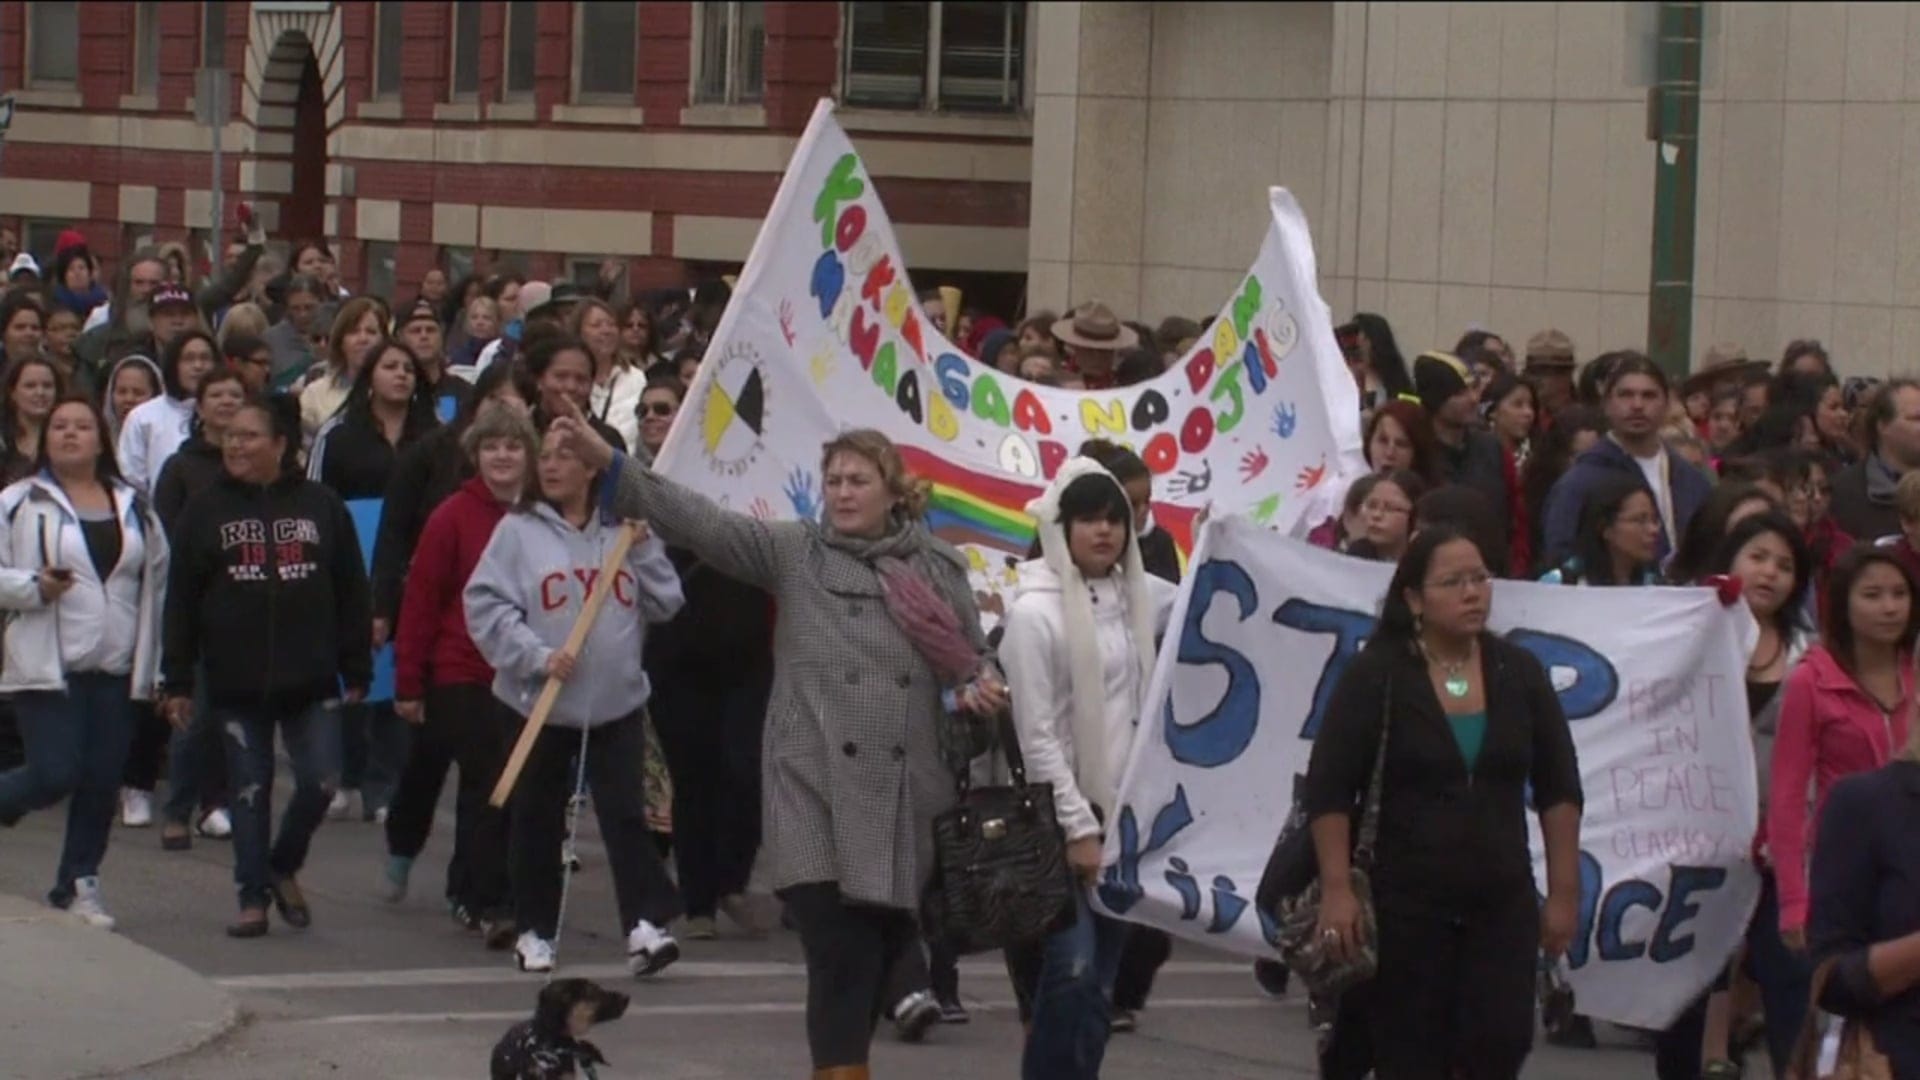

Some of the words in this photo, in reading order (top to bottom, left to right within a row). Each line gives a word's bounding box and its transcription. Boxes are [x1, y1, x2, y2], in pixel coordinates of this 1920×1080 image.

[1079, 388, 1169, 434] NA
[541, 568, 635, 611] CYC
[1647, 718, 1700, 758] IN
[1609, 762, 1737, 819] PEACE
